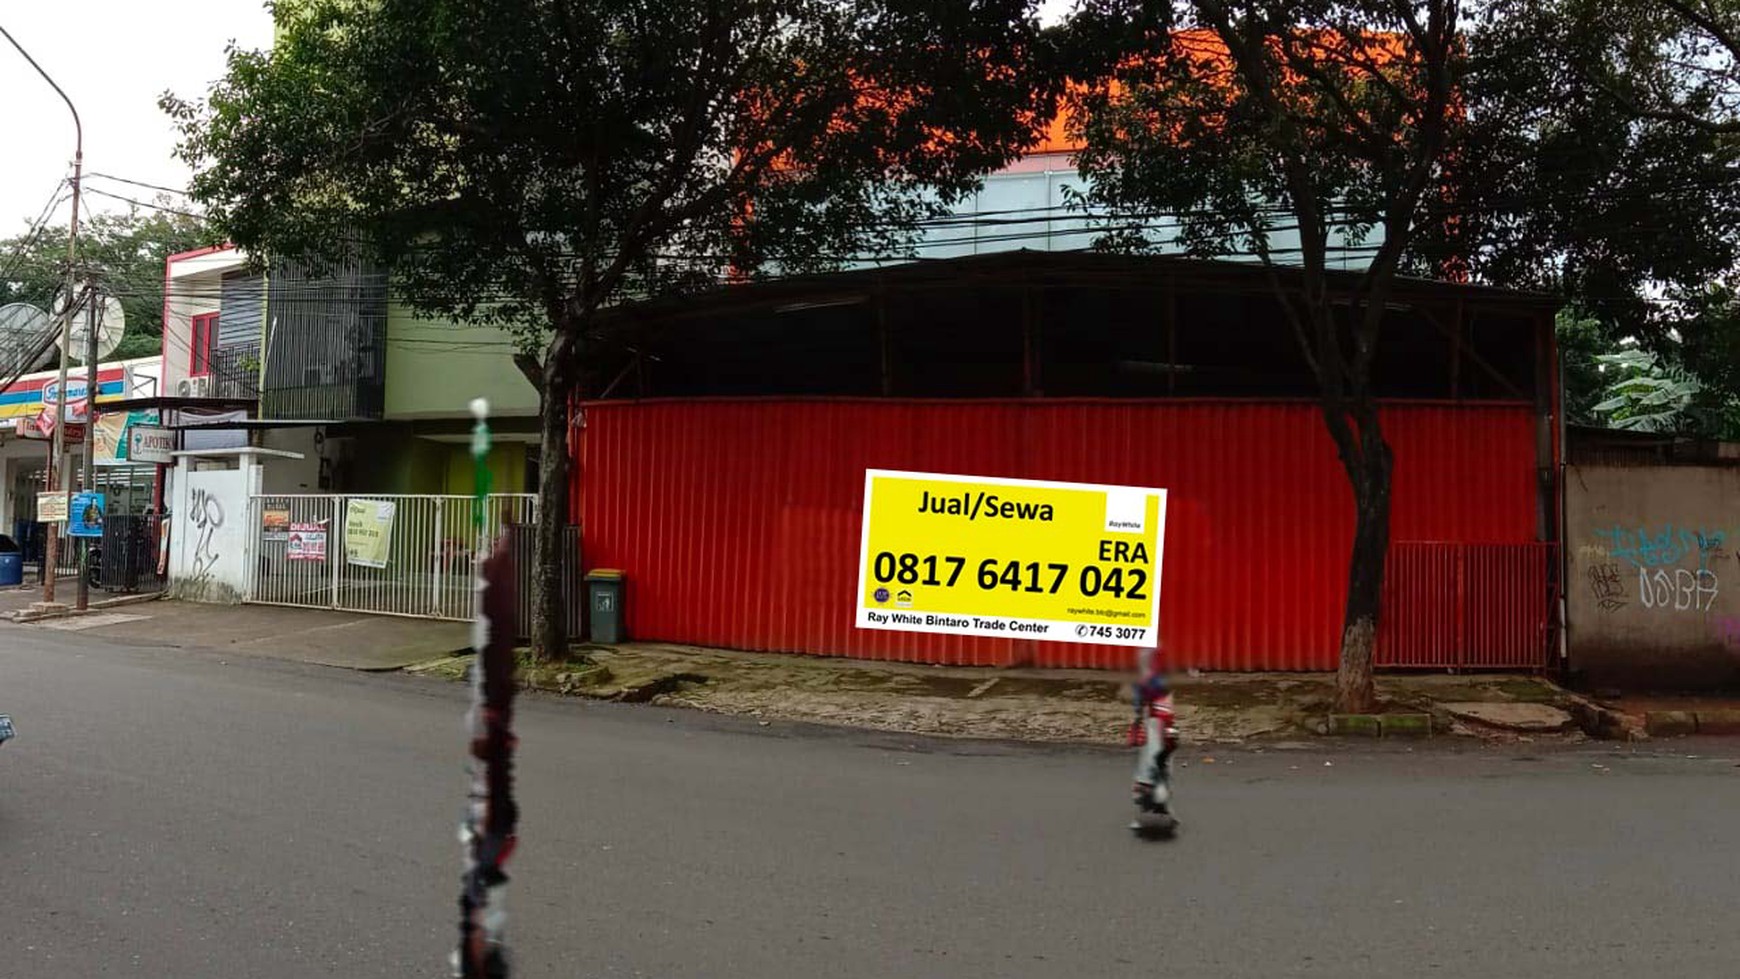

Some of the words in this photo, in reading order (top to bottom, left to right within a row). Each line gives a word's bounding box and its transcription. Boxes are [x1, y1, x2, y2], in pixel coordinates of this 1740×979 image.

[918, 491, 1054, 521] Jual/Sewa
[1098, 540, 1149, 564] ERA
[873, 551, 966, 587] 0817
[977, 558, 1069, 594] 6417
[1079, 565, 1147, 600] 042
[868, 612, 888, 624] Ray
[891, 614, 923, 625] White
[925, 615, 969, 628] Bintaro
[972, 618, 1006, 631] Trade
[1009, 621, 1049, 633] Center
[1089, 625, 1112, 638] 745
[1115, 627, 1146, 640] 3077
